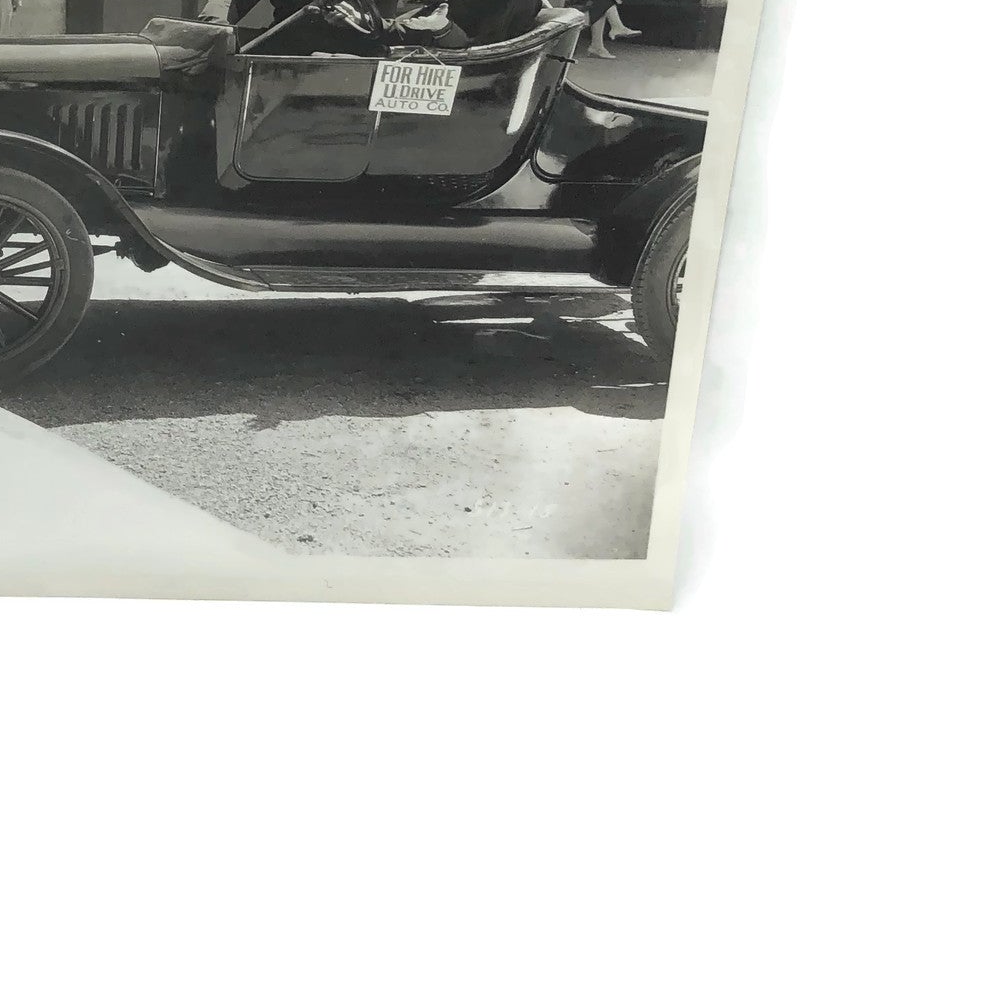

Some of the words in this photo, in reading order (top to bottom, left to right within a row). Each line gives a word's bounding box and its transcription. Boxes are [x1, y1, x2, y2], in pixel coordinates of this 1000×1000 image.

[381, 64, 413, 84] FOR
[416, 66, 457, 87] HIRE
[375, 98, 419, 110] AUTO
[426, 101, 450, 112] CO.
